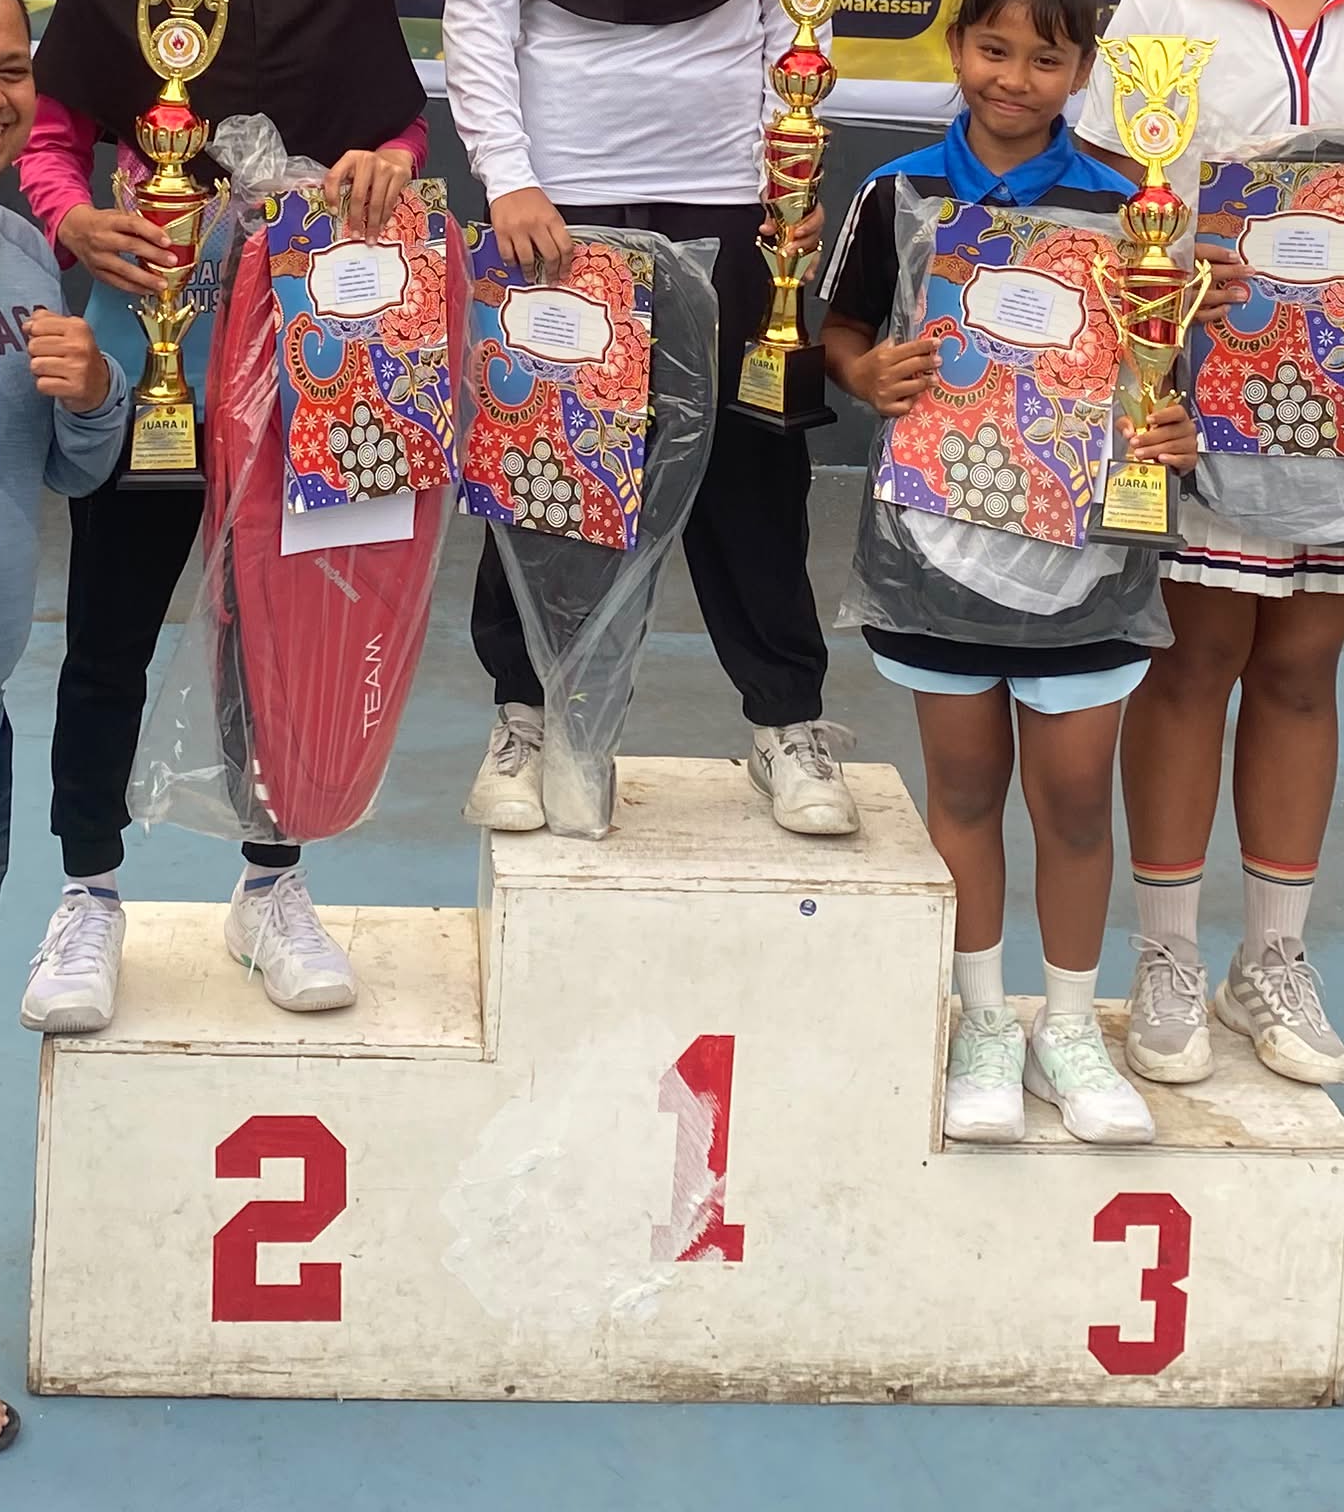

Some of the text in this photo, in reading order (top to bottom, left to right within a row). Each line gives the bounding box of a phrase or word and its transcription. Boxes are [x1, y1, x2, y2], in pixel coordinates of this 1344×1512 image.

[750, 358, 774, 371] JUARA
[142, 419, 188, 430] JUARA II
[1113, 477, 1161, 490] JUARA III
[363, 633, 383, 738] TEAM
[651, 1035, 746, 1263] 1
[211, 1114, 348, 1323] 2
[1086, 1191, 1192, 1377] 3
